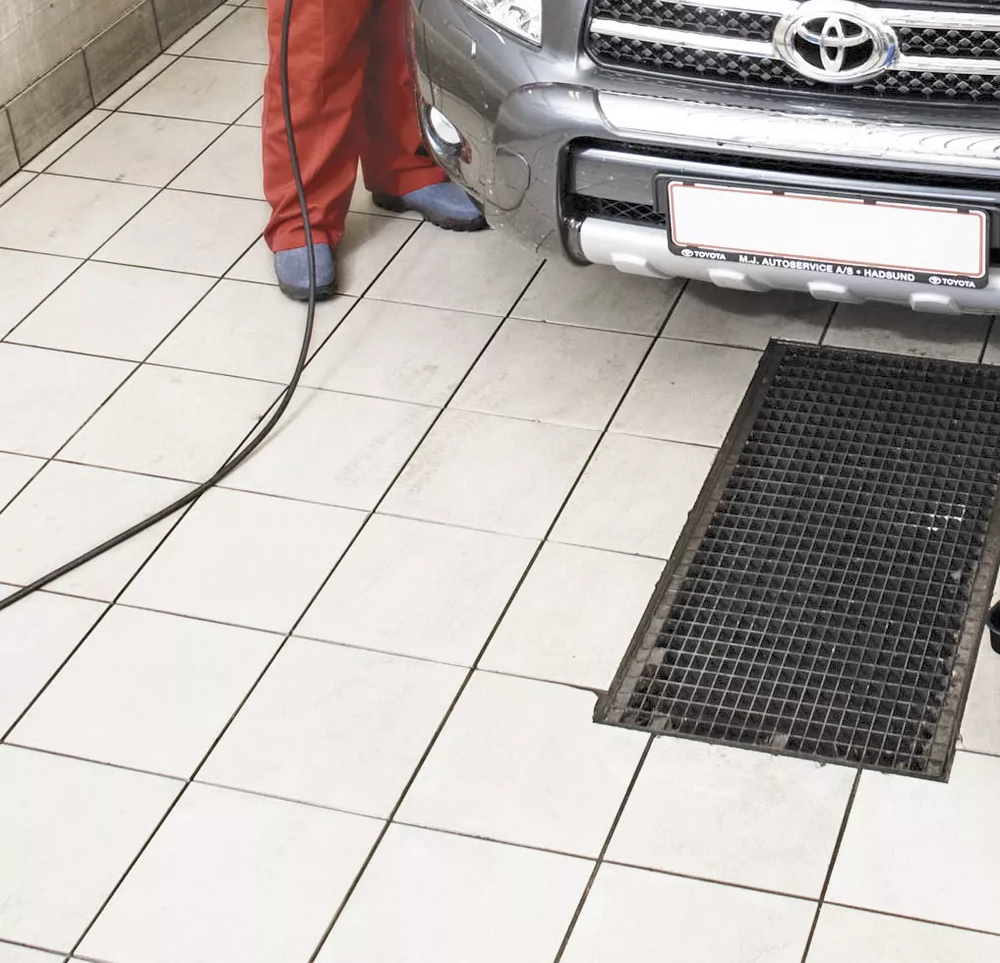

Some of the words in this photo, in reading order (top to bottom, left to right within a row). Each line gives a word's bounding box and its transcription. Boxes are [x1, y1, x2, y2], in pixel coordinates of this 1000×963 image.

[694, 250, 727, 261] TOYOTA
[739, 254, 760, 265] M.J.
[762, 257, 834, 273] AUTOSERVICE
[835, 264, 854, 276] A/S
[864, 268, 916, 282] HADSUND
[942, 277, 976, 288] TOYOTA
